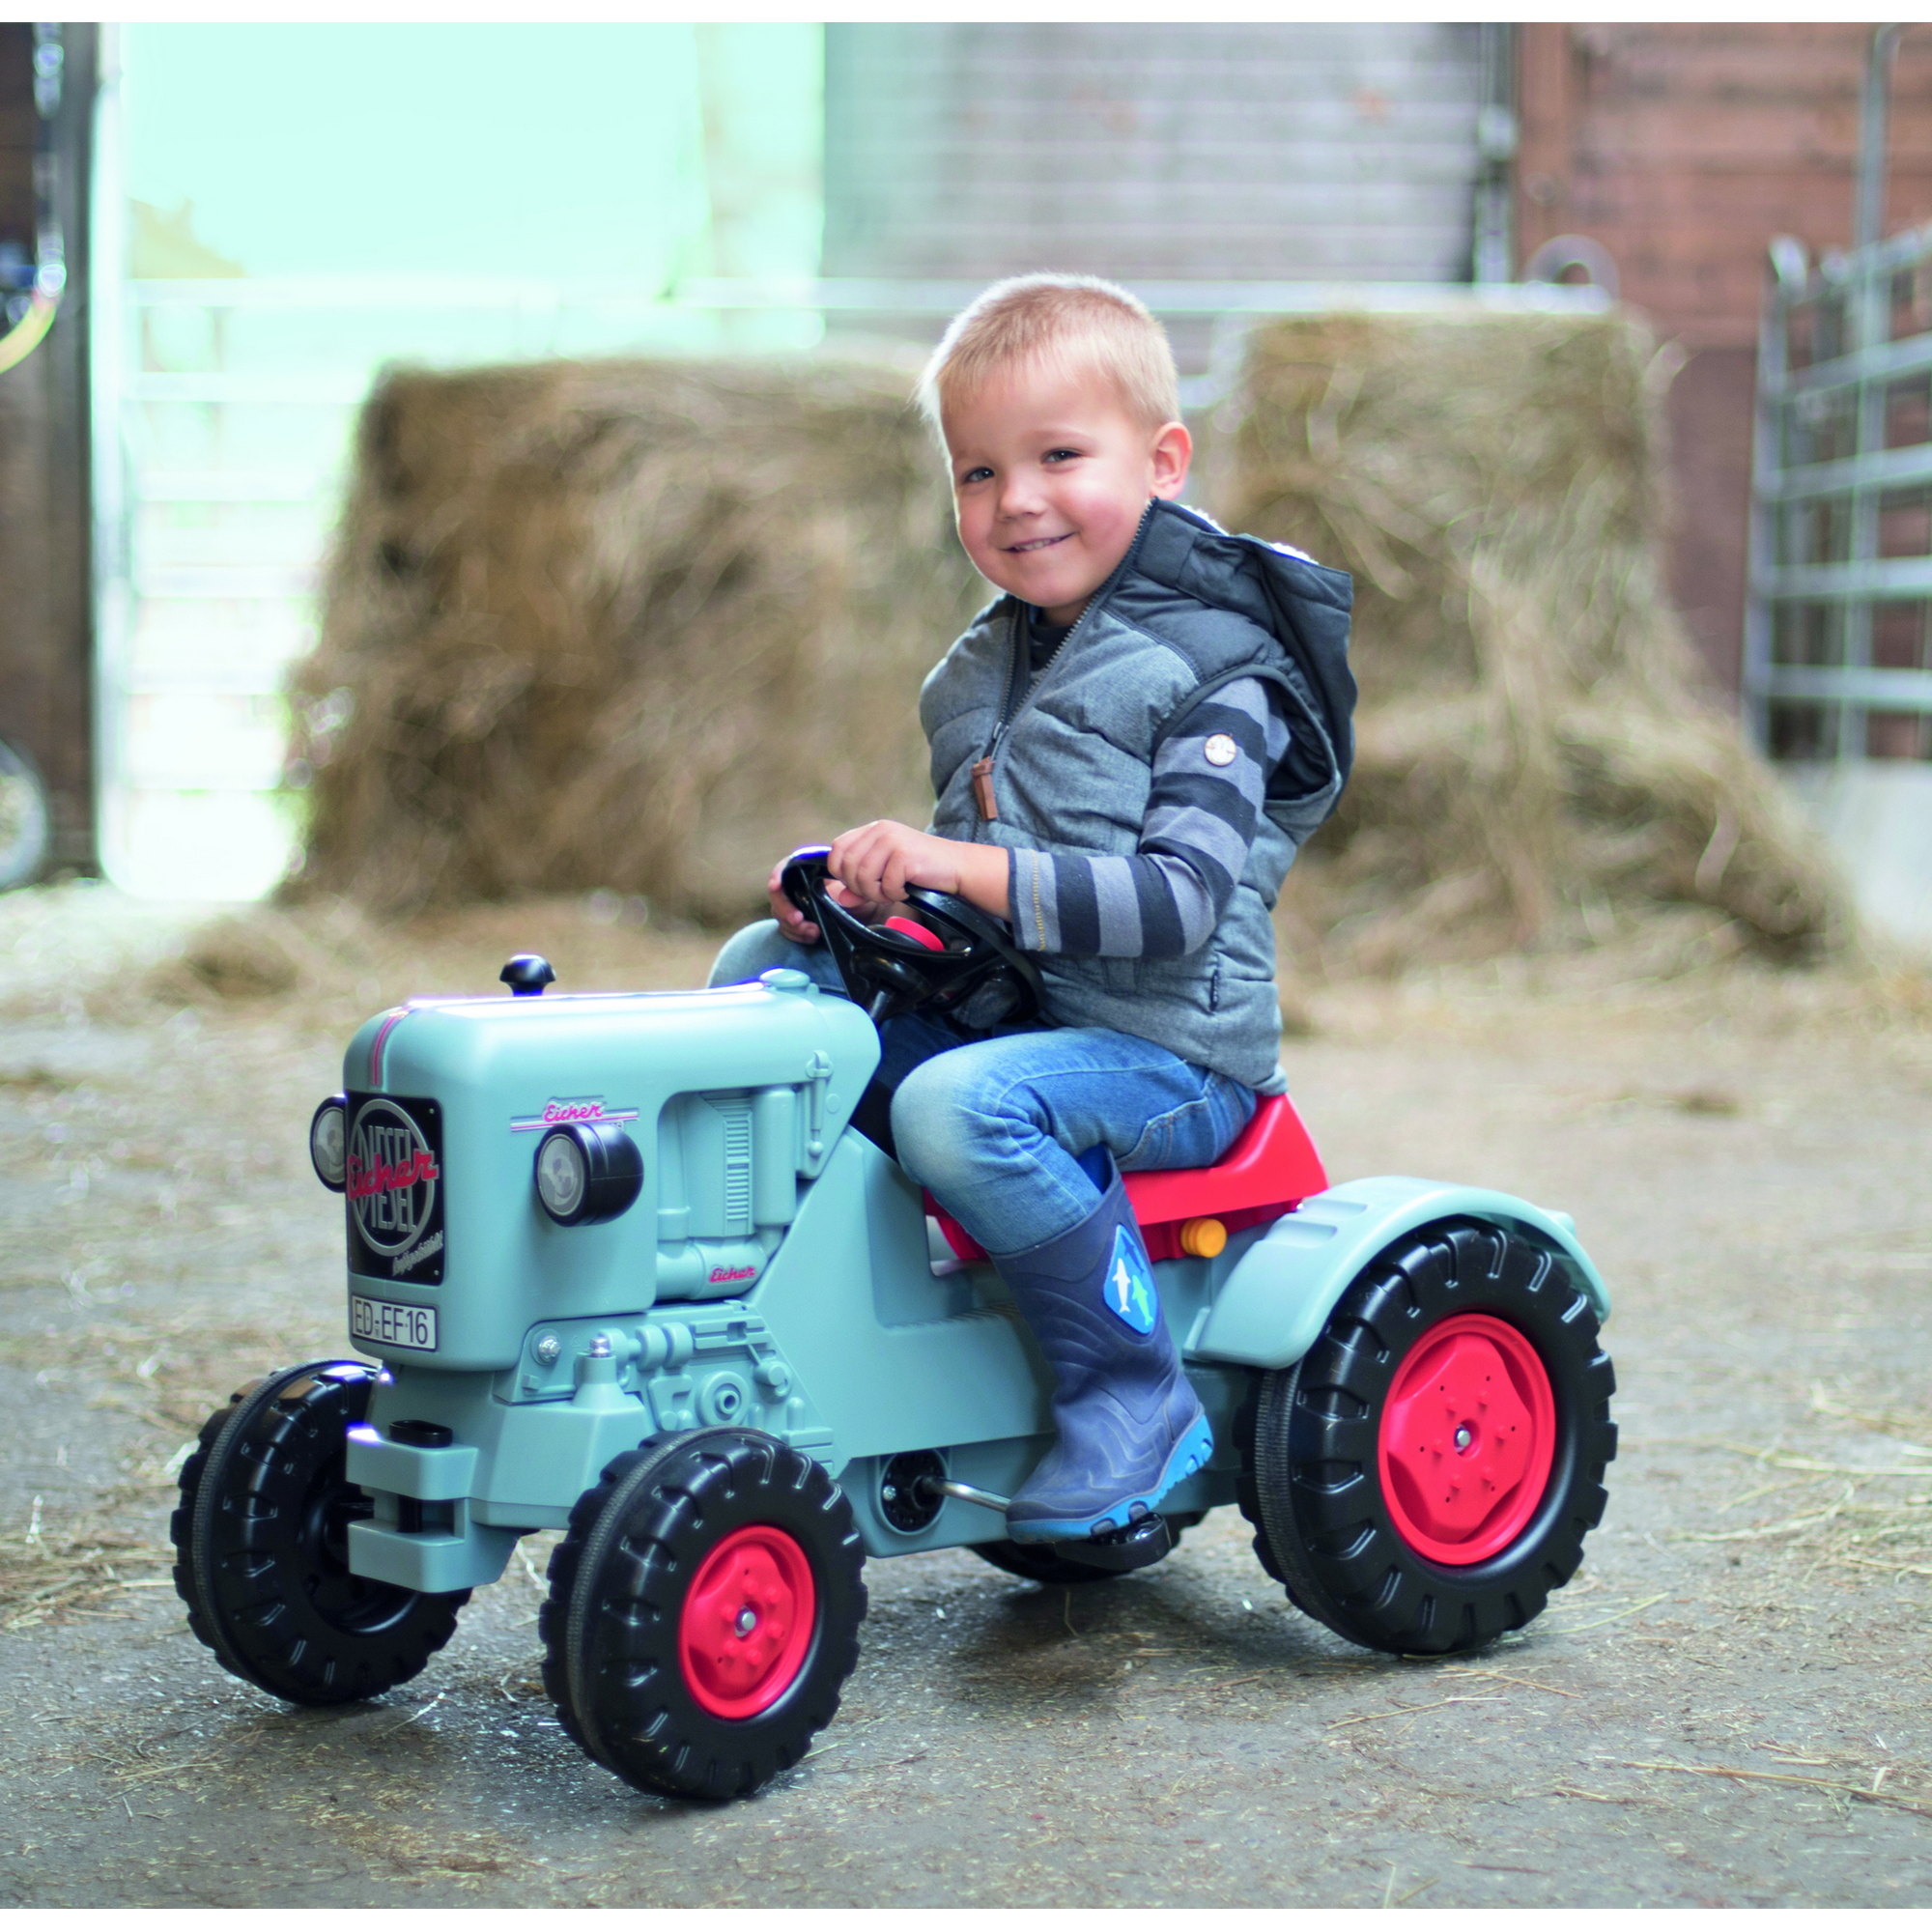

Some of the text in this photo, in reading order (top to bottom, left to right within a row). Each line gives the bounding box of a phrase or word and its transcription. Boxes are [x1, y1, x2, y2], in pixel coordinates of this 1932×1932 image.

[543, 1102, 603, 1122] Eicher
[348, 1150, 439, 1201] Eicher
[709, 1266, 755, 1283] Eicher
